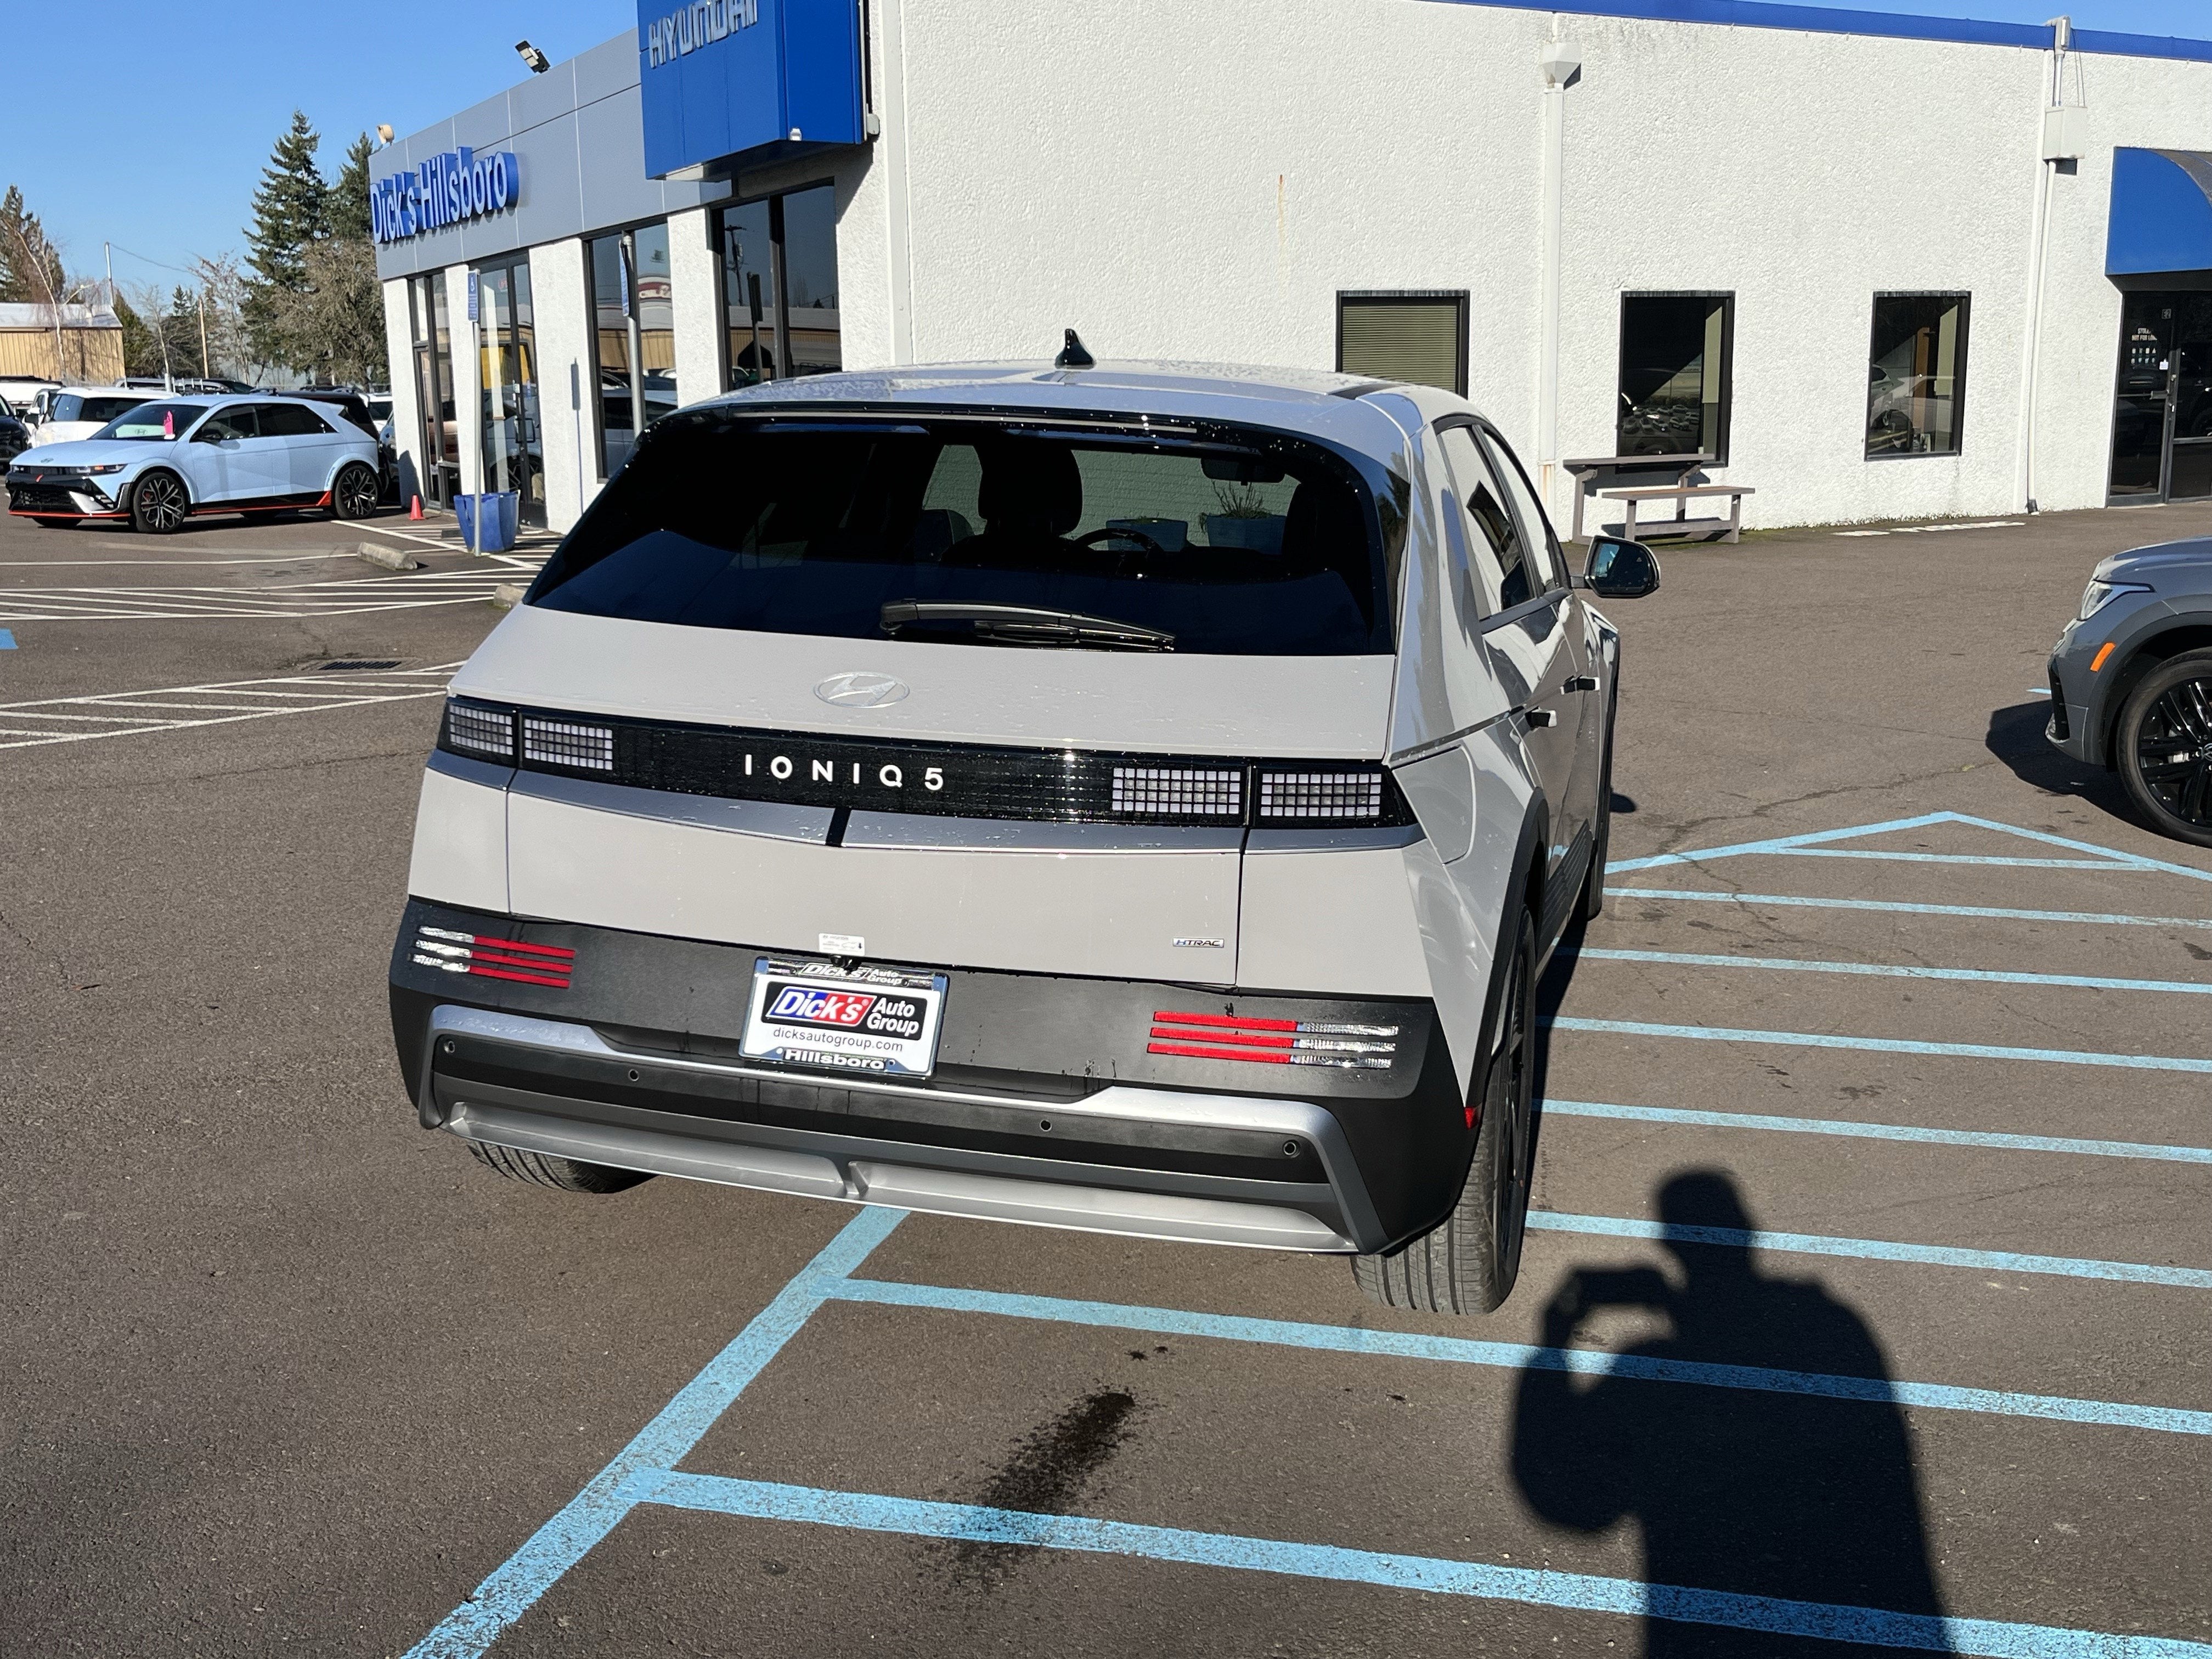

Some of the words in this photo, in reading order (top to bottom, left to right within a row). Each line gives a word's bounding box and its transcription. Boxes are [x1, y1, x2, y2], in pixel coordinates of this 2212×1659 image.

[648, 0, 758, 69] HYUNDAI
[370, 171, 417, 244] Dick's
[419, 146, 508, 230] Hillsboro
[744, 754, 902, 787] IONIQ
[924, 767, 944, 791] 5
[1176, 939, 1221, 947] HTRAC
[804, 964, 867, 978] Dicks
[871, 968, 899, 978] Auto
[867, 974, 903, 986] Group
[774, 990, 863, 1022] Dick's
[872, 997, 916, 1018] Auto
[866, 1012, 920, 1038] Group
[773, 1026, 904, 1053] dicksautogroup.com
[785, 1048, 886, 1070] Hillsboro
